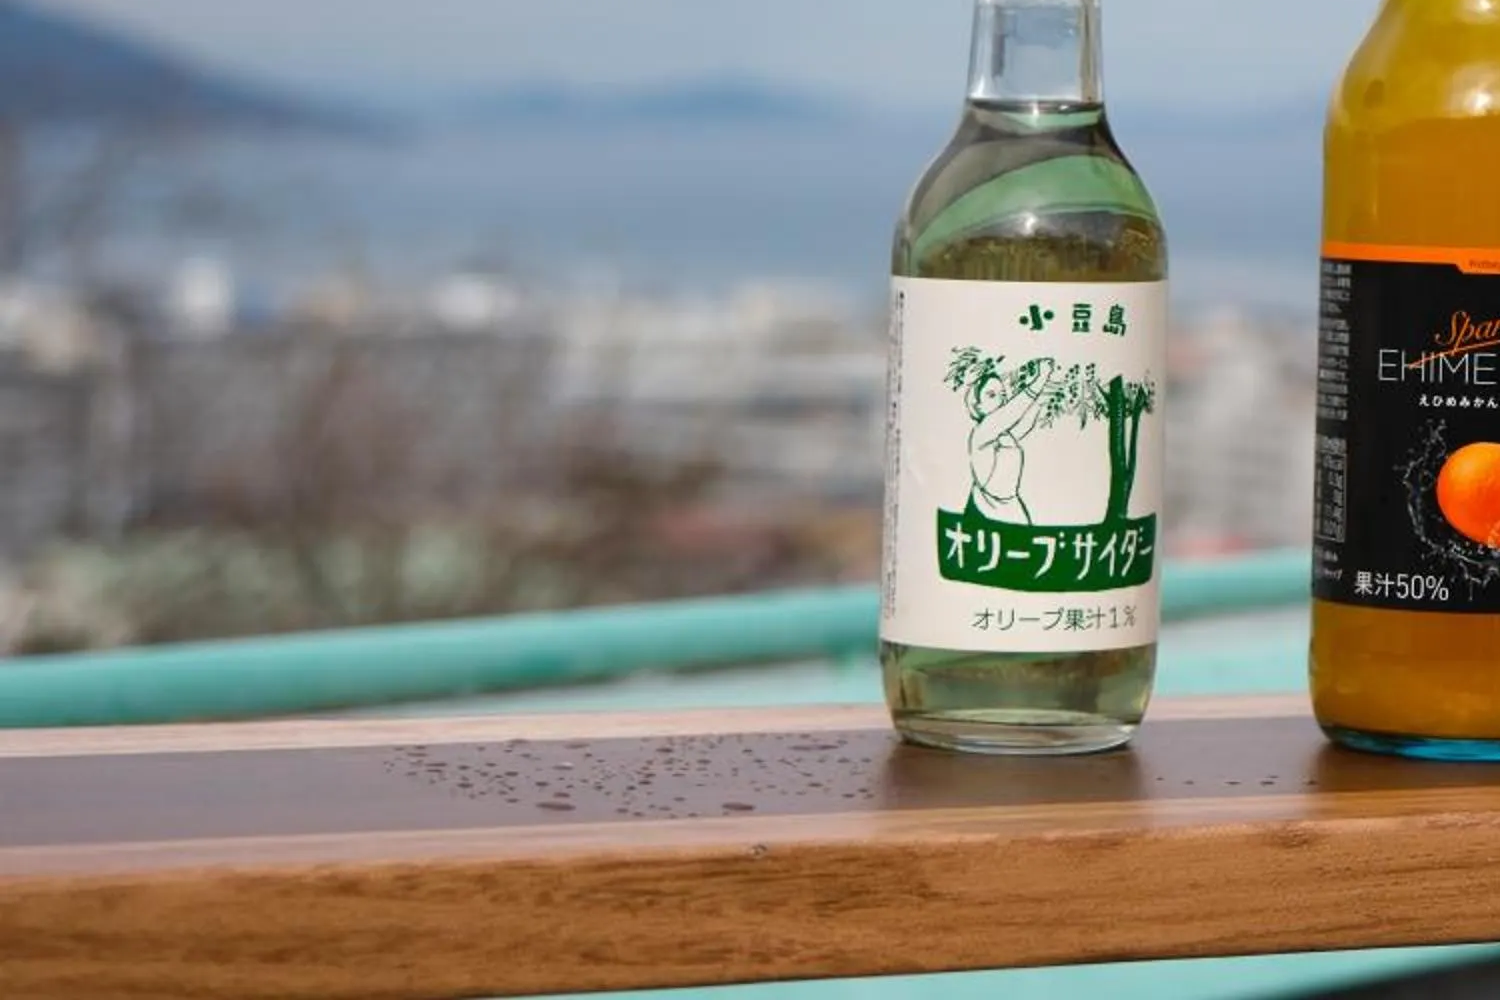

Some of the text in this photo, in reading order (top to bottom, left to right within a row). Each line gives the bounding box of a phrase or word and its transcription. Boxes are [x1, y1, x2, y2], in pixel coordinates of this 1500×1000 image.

[1019, 303, 1128, 336] 小豆島
[1378, 349, 1498, 386] EHIME
[945, 522, 1153, 581] オリーブサイダー
[1354, 569, 1450, 601] 果汁50%
[971, 604, 1138, 632] オリーブ果汁1%
